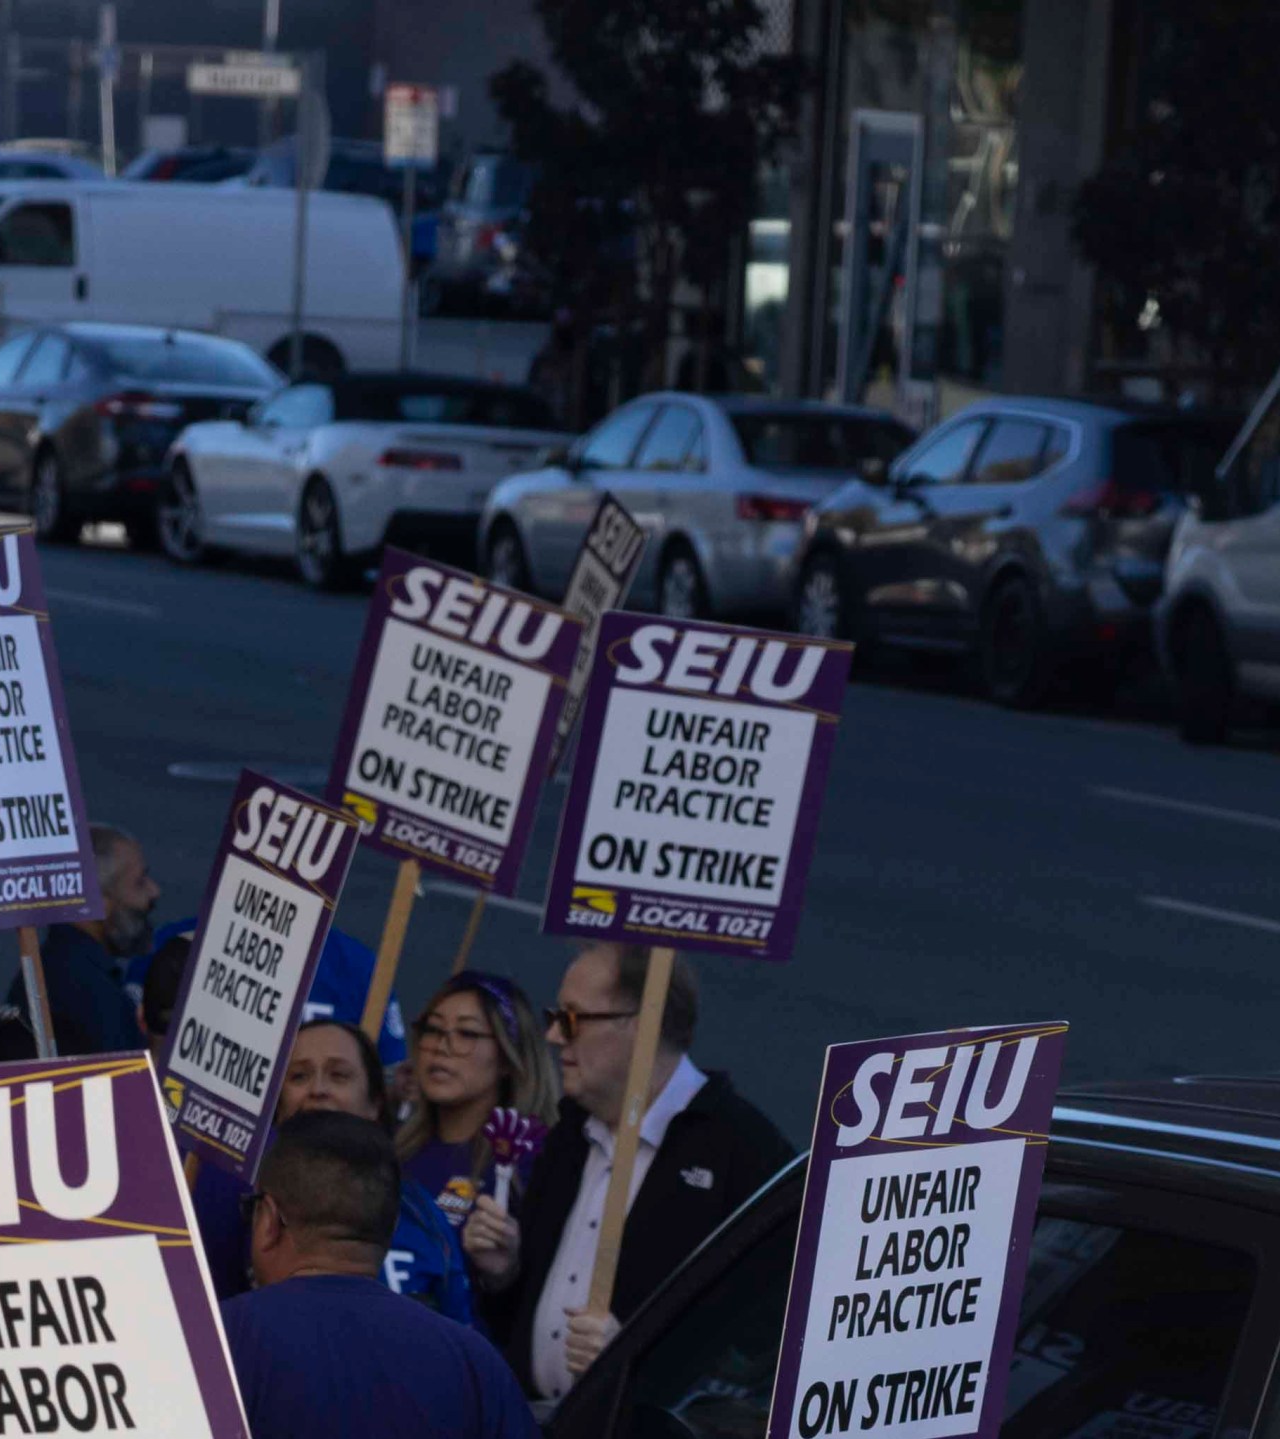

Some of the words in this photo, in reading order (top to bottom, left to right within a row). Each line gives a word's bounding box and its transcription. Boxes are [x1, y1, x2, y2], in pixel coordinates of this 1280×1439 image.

[390, 567, 561, 658] SEIU
[411, 642, 511, 702] UNFAIR
[616, 626, 824, 700] SEIU
[405, 676, 501, 734] LABOR
[646, 708, 770, 752] UNFAIR
[381, 702, 509, 772] PRACTICE
[642, 745, 760, 788] LABOR
[356, 748, 406, 792] ON
[408, 768, 510, 829] STRIKE
[614, 779, 774, 827] PRACTICE
[233, 786, 346, 881] SEIU
[587, 833, 648, 874] ON
[653, 842, 779, 889] STRIKE
[50, 872, 82, 895] 1021
[233, 878, 296, 937] UNFAIR
[566, 909, 613, 926] SEIU
[627, 905, 708, 930] LOCAL
[718, 916, 771, 936] 1021
[222, 922, 282, 978] LABOR
[202, 958, 281, 1024] PRACTICE
[178, 1017, 210, 1064] ON
[205, 1032, 270, 1095] STRIKE
[835, 1036, 1038, 1145] SEIU
[862, 1166, 981, 1223] UNFAIR
[855, 1223, 970, 1280] LABOR
[827, 1276, 981, 1340] PRACTICE
[798, 1378, 857, 1438] ON
[860, 1360, 982, 1430] STRIKE
